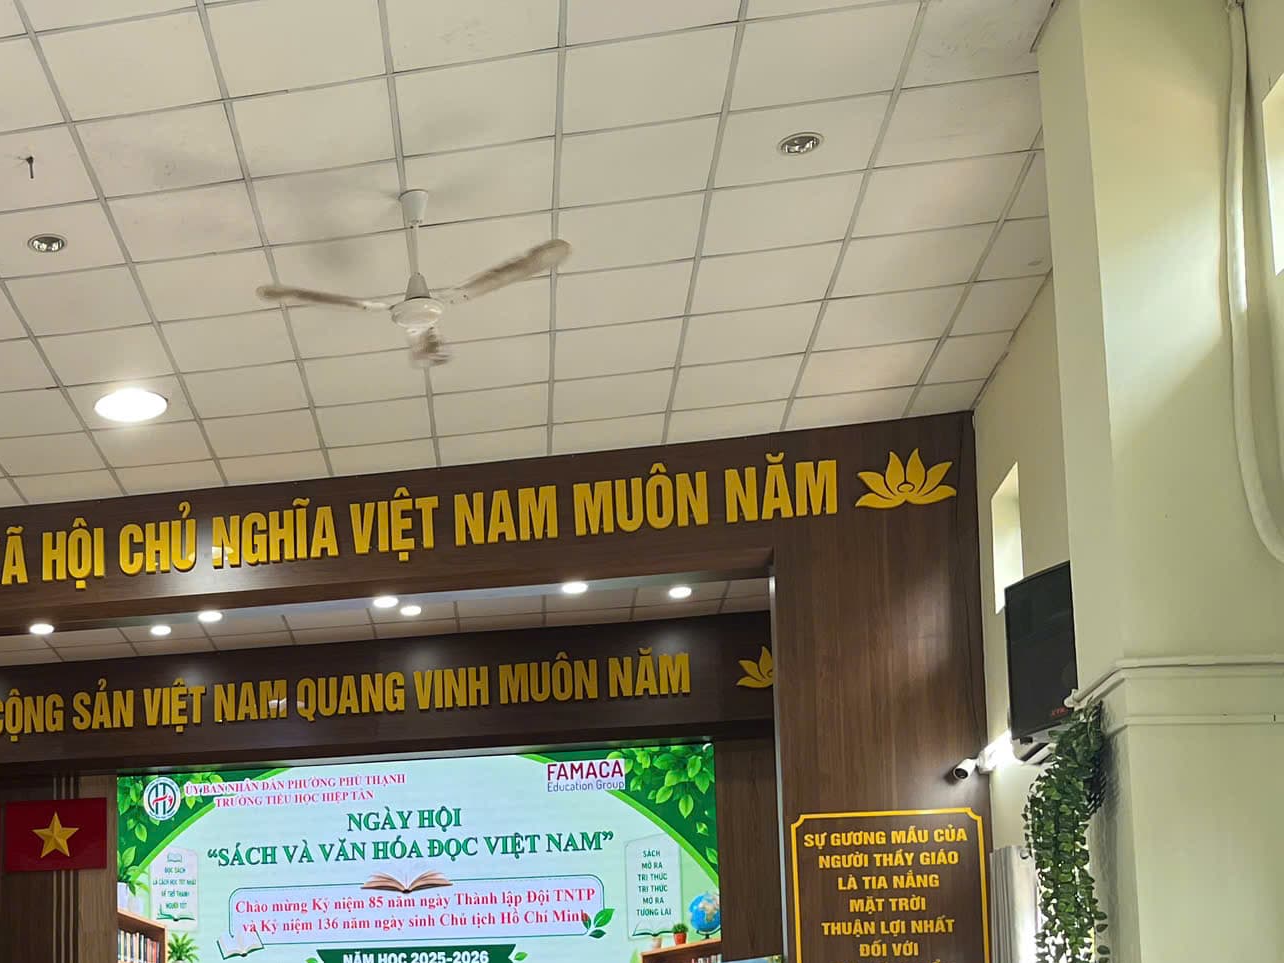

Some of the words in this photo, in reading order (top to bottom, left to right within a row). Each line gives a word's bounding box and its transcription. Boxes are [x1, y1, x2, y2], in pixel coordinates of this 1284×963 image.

[42, 517, 105, 590] HỘI
[119, 502, 196, 576] CHỦ
[211, 499, 338, 568] NGHĨA
[350, 487, 439, 562] VIỆT
[454, 486, 559, 546] NAM
[573, 463, 710, 537] MUÔN
[724, 453, 839, 523] NĂM
[72, 678, 133, 732] SẢN
[143, 678, 206, 733] VIỆT
[214, 679, 288, 721] NAM
[296, 670, 405, 721] QUANG
[413, 666, 489, 709] VINH
[499, 651, 600, 704] MUÔN
[609, 646, 691, 697] NĂM
[547, 760, 624, 781] FAMACA
[547, 781, 594, 793] Education
[596, 779, 625, 792] Group
[347, 806, 412, 832] NGÀY
[418, 805, 461, 832] HỘI
[282, 839, 316, 864] VÀ
[319, 837, 366, 862] VĂN
[371, 834, 422, 860] HÓA
[427, 838, 478, 861] ĐỌC
[483, 832, 540, 859] VIỆT
[804, 831, 826, 849] SỰ
[830, 831, 886, 846] GƯƠNG
[891, 825, 929, 844] MẪU
[934, 824, 967, 842] CỦA
[819, 851, 869, 868] NGƯỜI
[920, 848, 959, 865] GIÁO
[838, 873, 858, 890] LÀ
[862, 876, 888, 889] TIA
[235, 900, 268, 913] Chào
[334, 896, 364, 913] niệm
[369, 896, 383, 908] 85
[388, 895, 415, 908] năm
[420, 894, 451, 910] ngày
[454, 892, 497, 906] Thành
[502, 891, 522, 908] lập
[527, 889, 550, 907] Đội
[554, 888, 596, 901] TNTP
[849, 896, 885, 914] MẶT
[889, 894, 926, 911] TRỜI
[283, 918, 313, 933] niệm
[318, 917, 339, 930] 136
[343, 916, 370, 930] năm
[409, 912, 435, 928] sinh
[472, 911, 496, 928] tịch
[524, 910, 548, 924] Chí
[821, 918, 876, 937] THUẬN
[881, 919, 906, 937] LỢI
[911, 914, 955, 933] NHẤT
[859, 939, 887, 957] ĐỐI
[892, 940, 919, 956] VỚI
